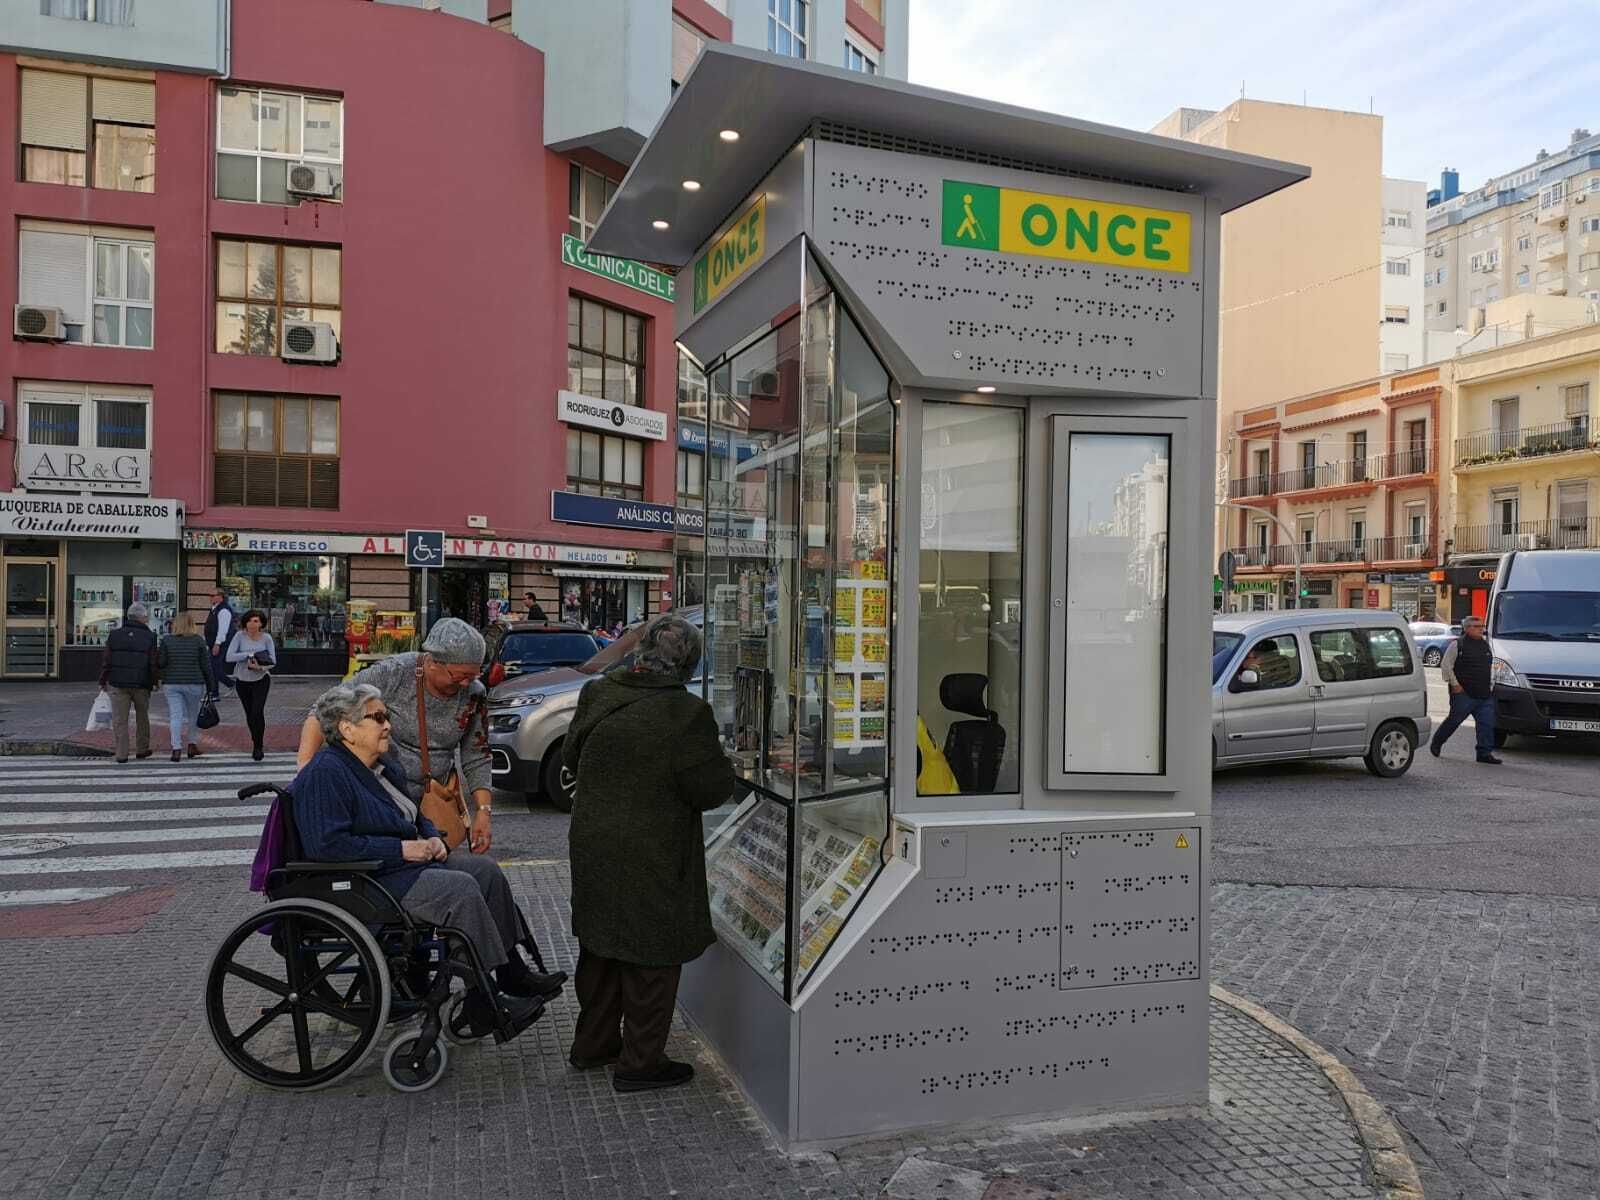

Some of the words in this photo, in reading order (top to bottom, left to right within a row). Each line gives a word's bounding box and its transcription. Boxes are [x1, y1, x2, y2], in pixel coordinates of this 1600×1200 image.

[1021, 203, 1171, 261] ONCE
[713, 209, 759, 286] ONCE
[639, 270, 664, 294] DEL
[67, 503, 83, 514] DE
[88, 504, 168, 517] CABALLEROS
[617, 504, 660, 522] ANÁLISIS
[662, 511, 703, 527] CLNICOS
[12, 516, 140, 534] Vistahermosa
[249, 539, 328, 550] REFRESCO
[567, 551, 608, 562] HELADOS
[1479, 569, 1497, 580] Ora
[1559, 680, 1594, 688] IVECO
[1558, 721, 1578, 729] 1021
